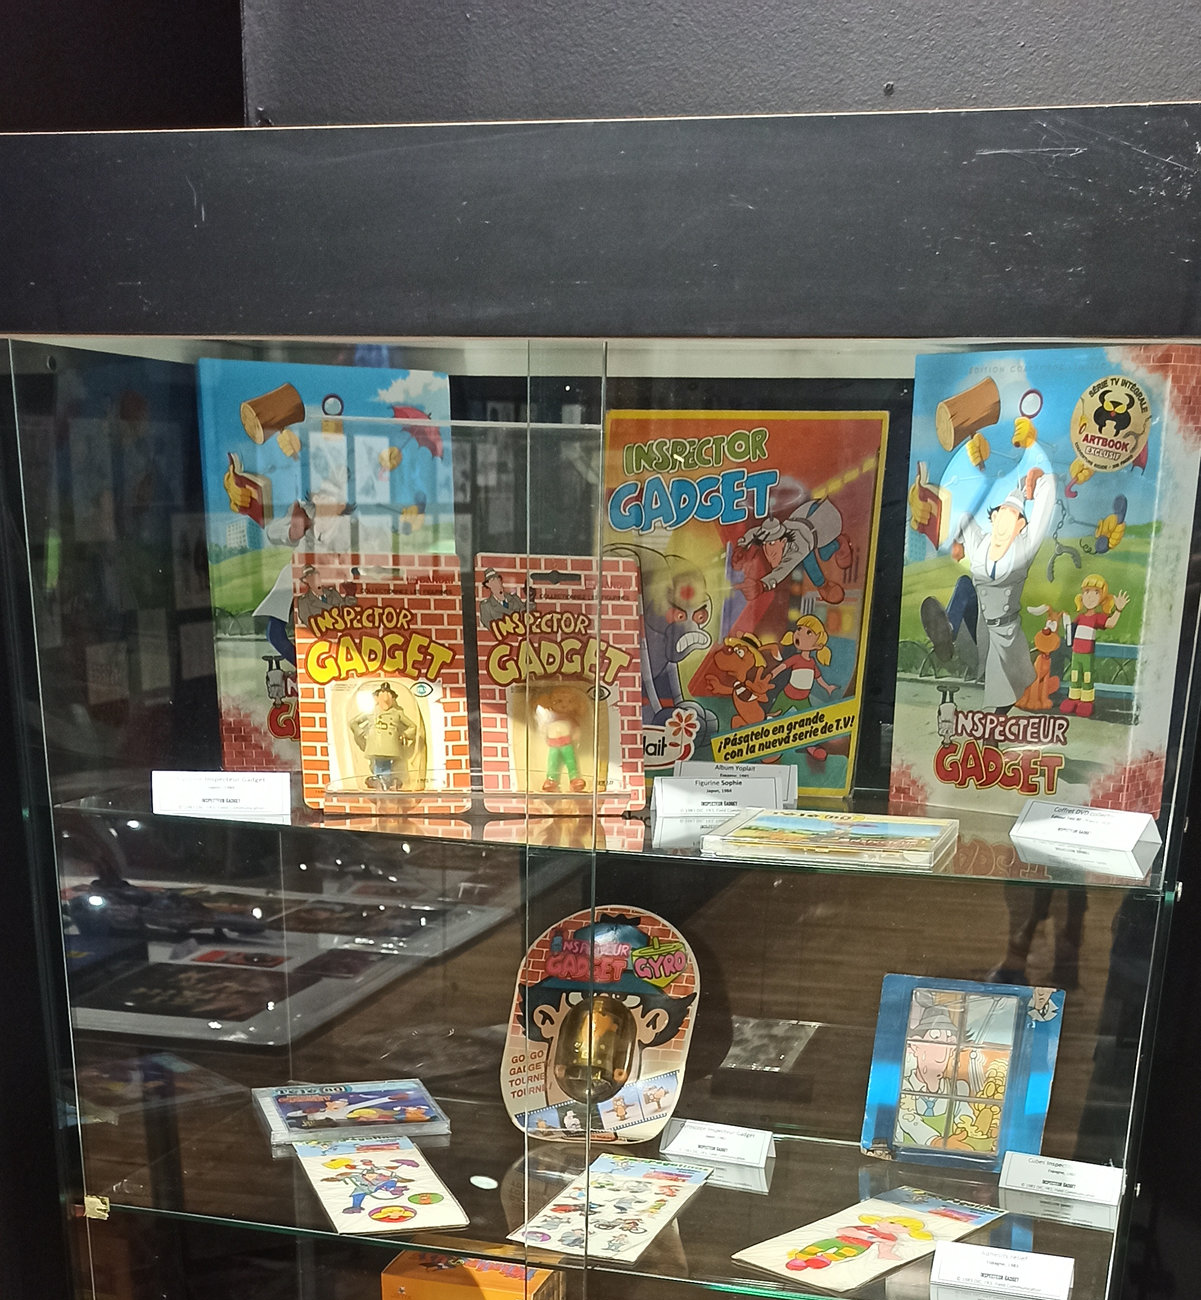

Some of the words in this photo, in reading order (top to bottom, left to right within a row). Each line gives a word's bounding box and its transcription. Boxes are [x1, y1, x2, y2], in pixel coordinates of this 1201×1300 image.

[1088, 379, 1109, 398] SÉRIE
[1110, 378, 1120, 386] TV
[1120, 379, 1149, 413] INTÉGRALE
[623, 427, 770, 476] INSPECTOR
[1082, 433, 1130, 452] ARTBOOK
[1086, 446, 1121, 460] EXCLUSIF
[607, 468, 780, 535] GADGET
[308, 606, 413, 638] INSPECTOR
[491, 611, 590, 642] INSPECTOR
[305, 631, 456, 684] GADGET
[487, 637, 633, 686] GADGET
[643, 736, 668, 757] lait
[717, 728, 771, 754] ¡Pásatelo
[772, 725, 785, 737] en
[785, 711, 826, 738] grande
[723, 747, 744, 762] con
[745, 741, 756, 756] la
[757, 735, 791, 753] nueva
[791, 728, 818, 744] serie
[818, 722, 834, 736] de
[735, 765, 756, 773] Yoplait
[933, 739, 1066, 796] GADGET
[721, 780, 743, 788] Sophie
[1053, 806, 1075, 815] Coffret
[1075, 808, 1090, 816] DVD
[634, 951, 687, 979] GYRO
[511, 1054, 526, 1064] GO
[530, 1050, 544, 1060] GO
